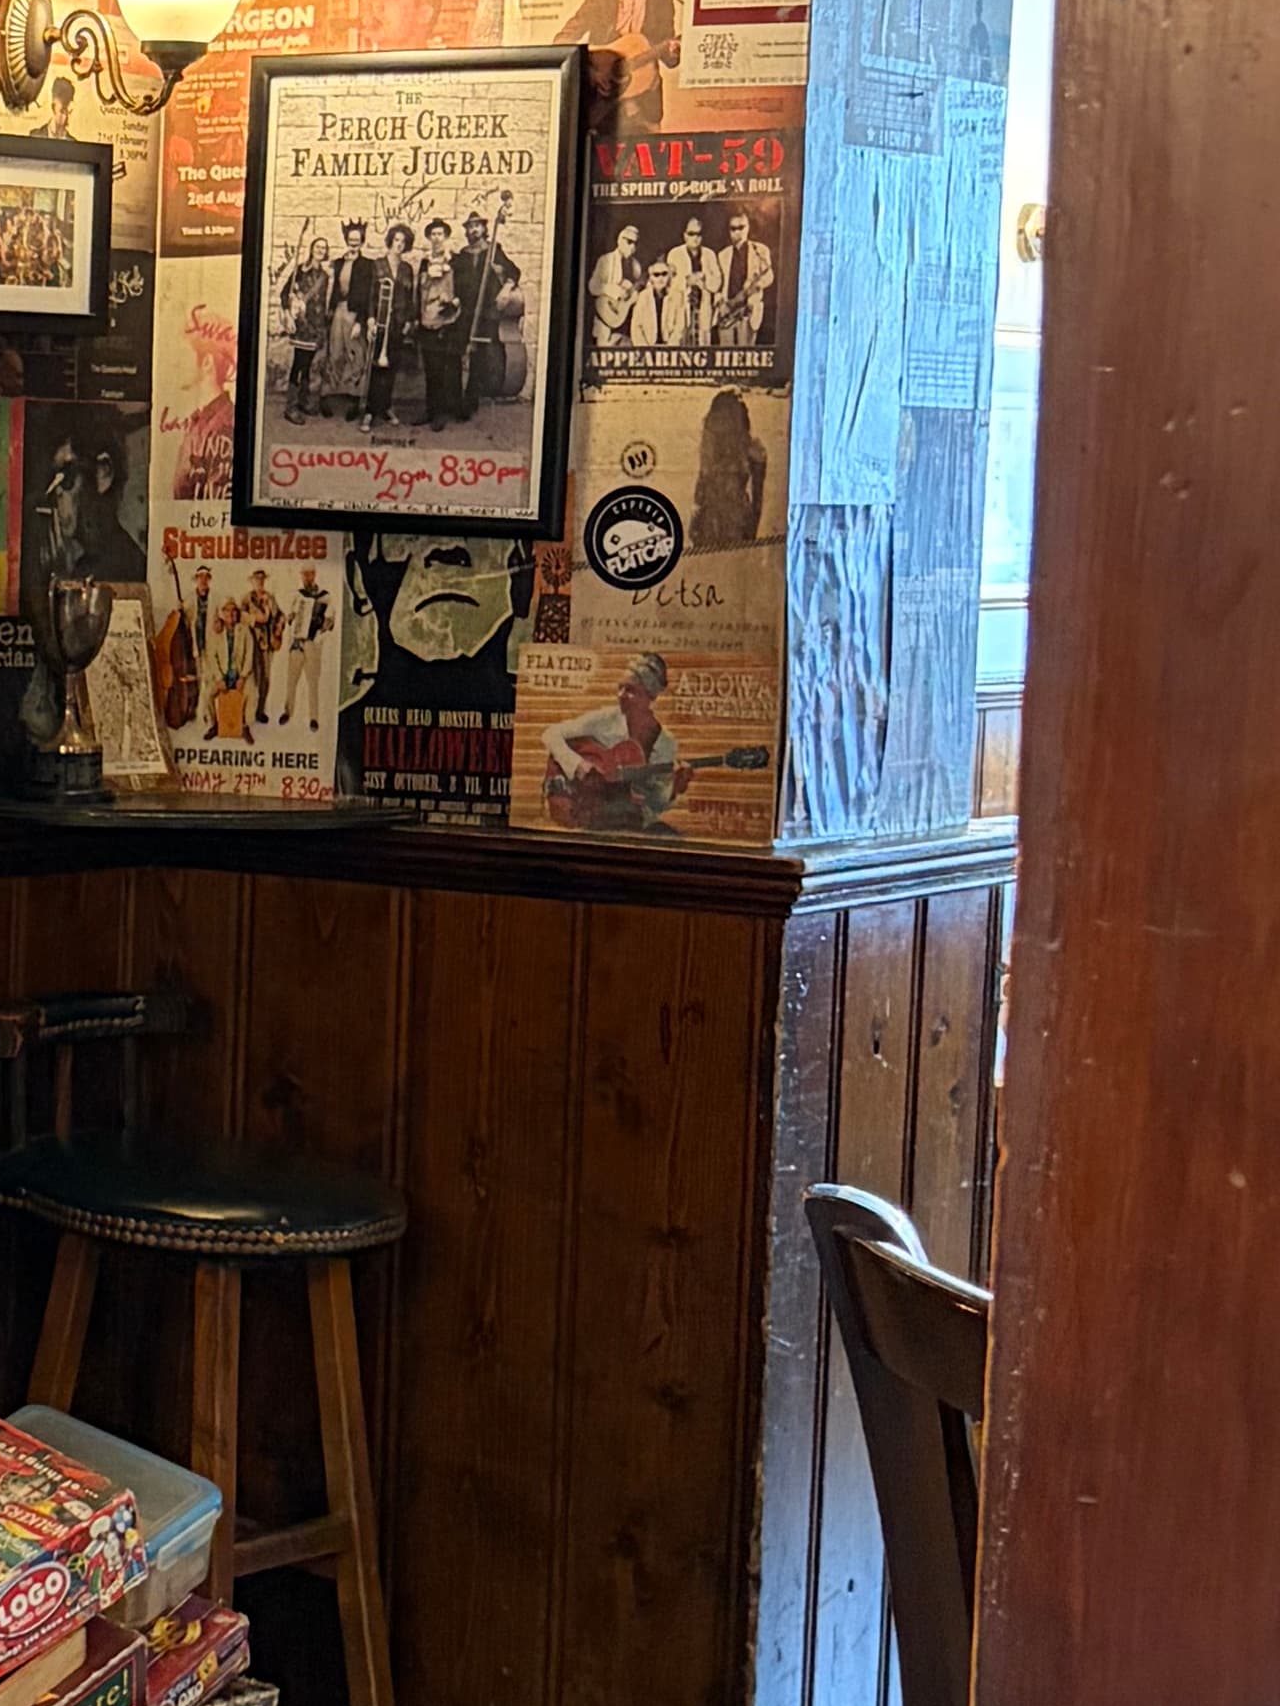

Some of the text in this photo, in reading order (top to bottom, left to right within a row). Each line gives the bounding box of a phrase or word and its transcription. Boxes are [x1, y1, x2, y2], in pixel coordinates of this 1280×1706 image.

[226, 5, 314, 33] RGEON
[396, 91, 423, 105] THE
[122, 120, 149, 134] Sunday
[318, 109, 509, 142] PERCH CREEK
[291, 146, 534, 178] FAMILY JUGBAND
[595, 137, 785, 178] VAT-59
[177, 166, 207, 182] The
[593, 182, 618, 197] THE
[621, 180, 666, 197] SPIRIT
[690, 178, 727, 195] ROCK
[748, 177, 783, 193] ROLL
[188, 191, 245, 207] 2nd Aug
[591, 350, 774, 368] APPEARING HERE
[269, 448, 389, 488] SUNDAY
[190, 511, 231, 529] the F
[527, 655, 592, 671] PLAYING
[271, 751, 319, 769] HERE
[16, 1450, 61, 1481] things
[0, 1503, 70, 1541] WALKERS
